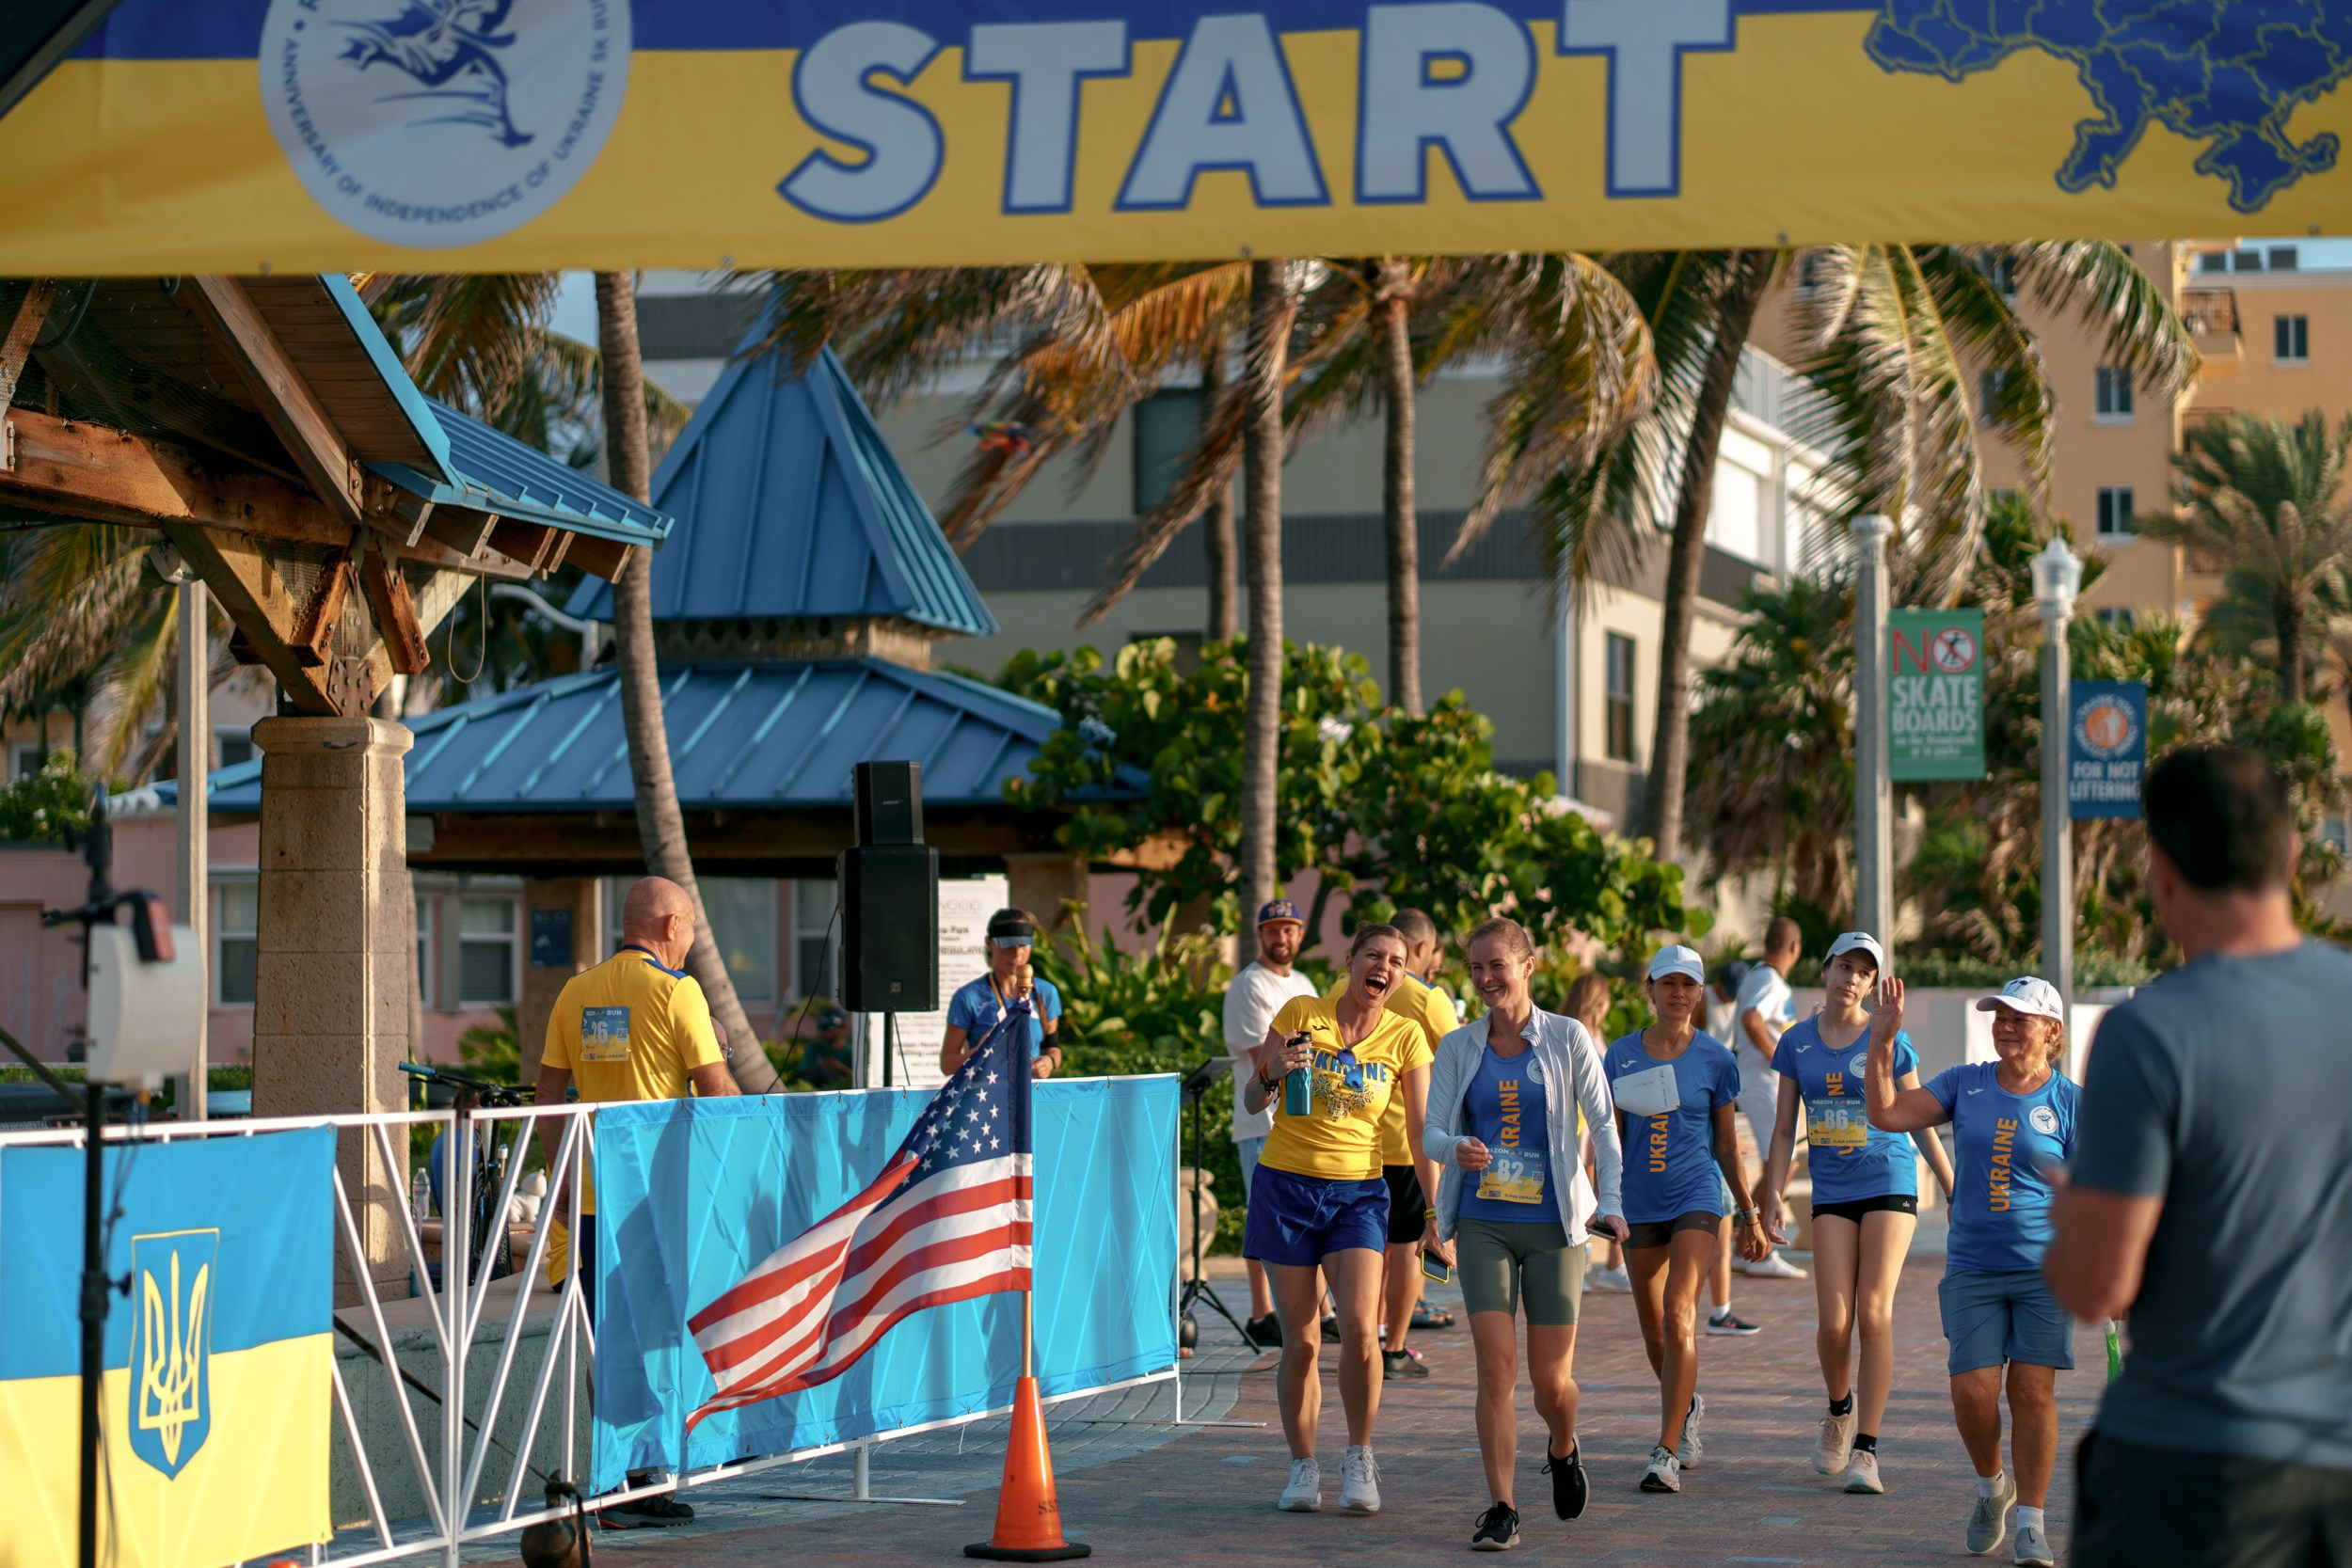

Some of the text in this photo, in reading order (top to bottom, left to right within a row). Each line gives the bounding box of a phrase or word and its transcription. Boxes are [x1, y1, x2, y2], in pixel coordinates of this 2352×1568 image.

[284, 38, 341, 177] ANNIVERSARY
[338, 175, 364, 197] OF
[364, 183, 523, 224] INDEPENDENCE
[525, 158, 552, 189] OF
[551, 70, 606, 162] UKRAINE
[590, 0, 611, 32] RU
[773, 0, 1736, 224] START
[1892, 675, 1978, 708] SKATE
[1892, 708, 1978, 734] BOARDS
[2073, 761, 2140, 780] FOR NOT
[2070, 780, 2141, 800] LITTERING
[1499, 1079, 1521, 1148] KRAINE
[1824, 1108, 1849, 1131] 86
[1649, 1114, 1669, 1173] UKRAI
[1497, 1159, 1524, 1184] 82
[1989, 1117, 2018, 1212] UKRAINE
